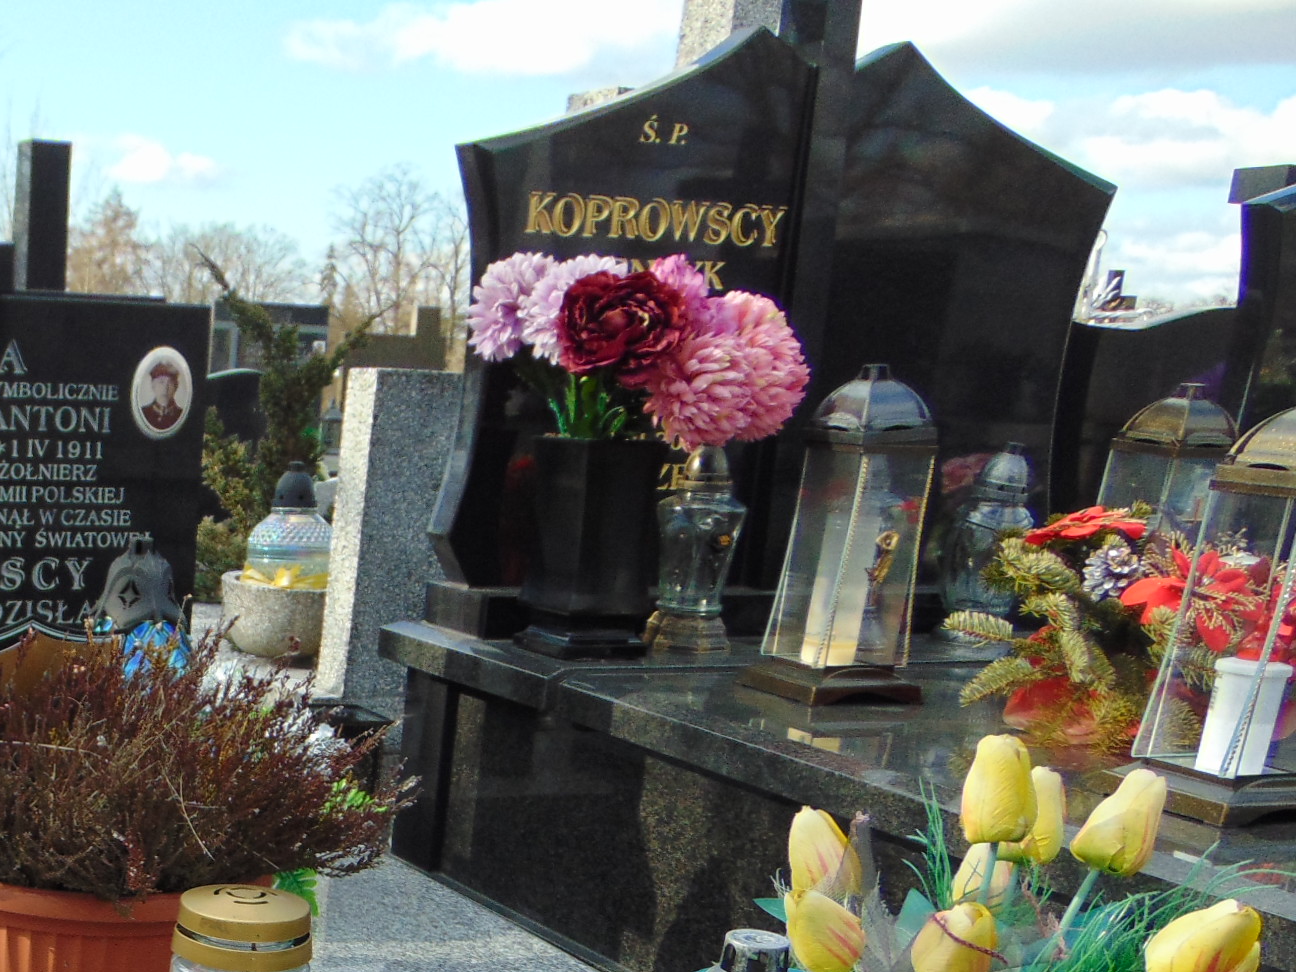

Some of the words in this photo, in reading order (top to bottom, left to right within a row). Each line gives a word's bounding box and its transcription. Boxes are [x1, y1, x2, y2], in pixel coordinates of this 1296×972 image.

[524, 190, 788, 247] KOPROWSCY
[27, 439, 50, 458] IV
[56, 440, 103, 459] 1911
[31, 486, 125, 504] POLSKIEJ
[39, 508, 57, 525] W
[60, 509, 132, 526] CZASIE
